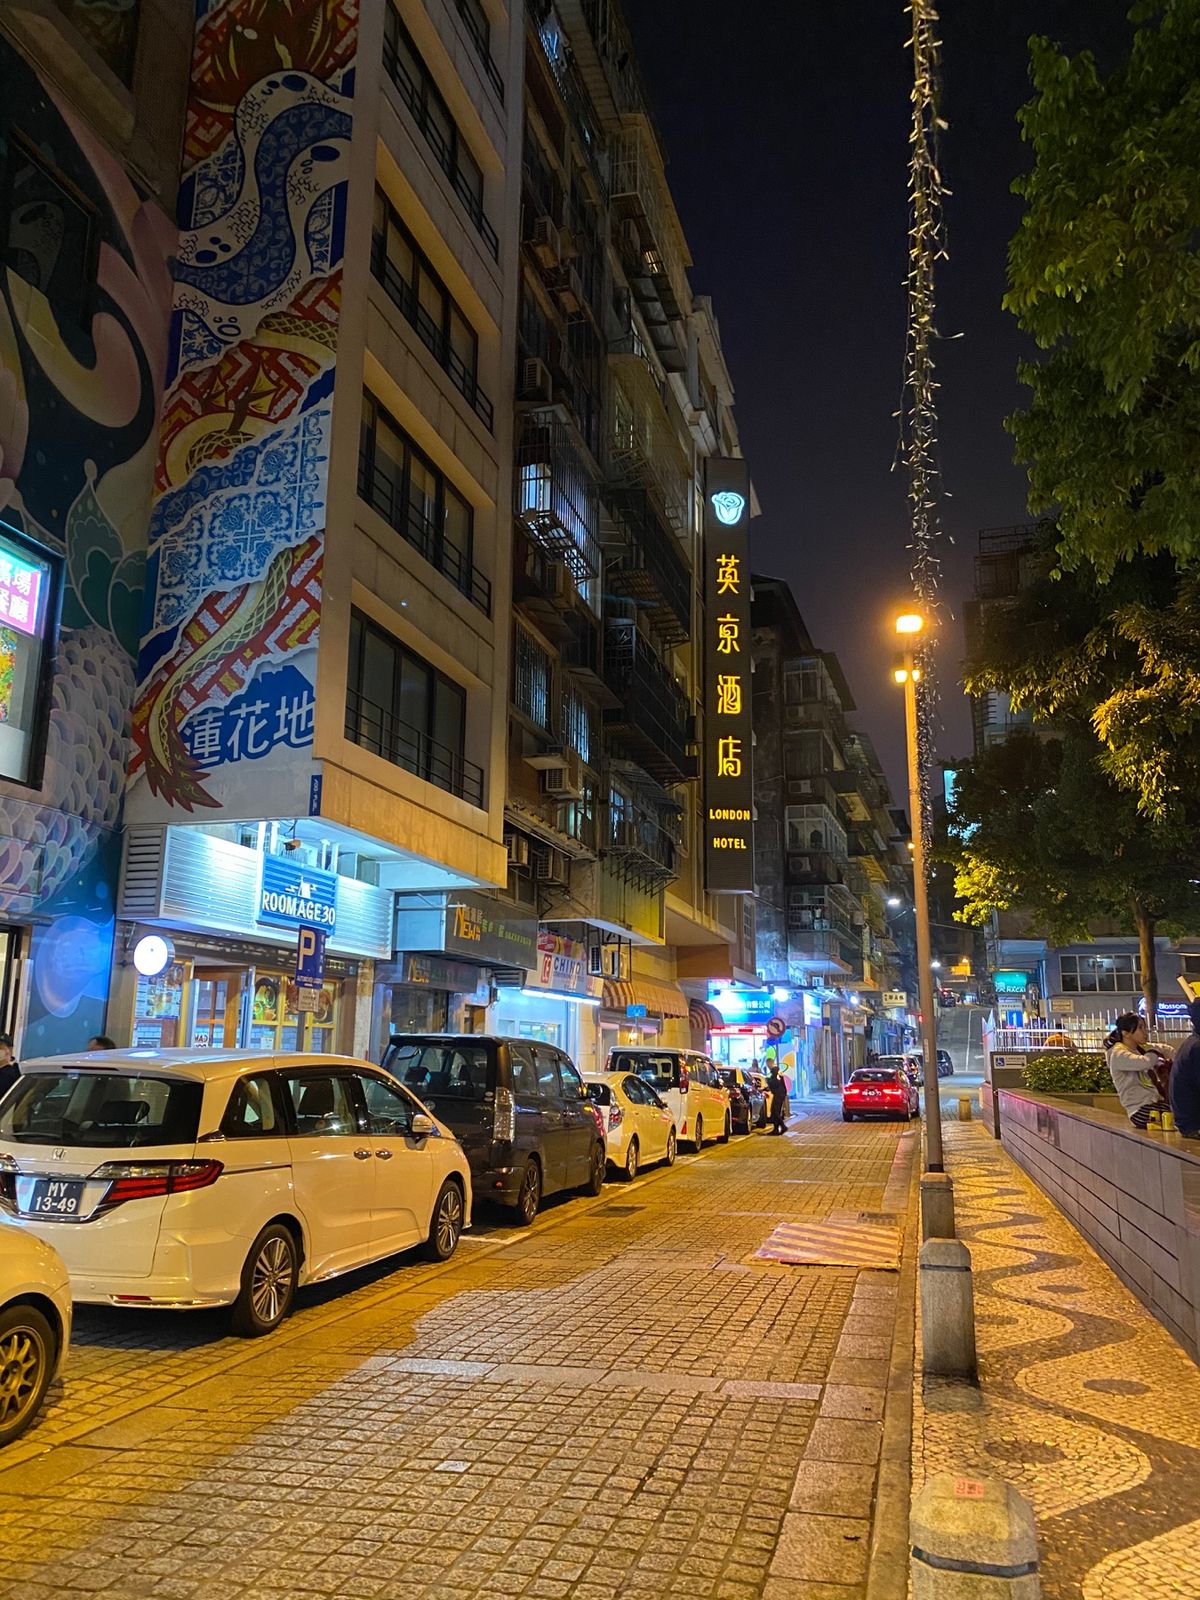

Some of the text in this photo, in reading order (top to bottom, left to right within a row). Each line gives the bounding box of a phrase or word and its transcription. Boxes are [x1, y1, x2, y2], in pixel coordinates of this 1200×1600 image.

[716, 554, 742, 777] 英京酒店
[709, 809, 750, 820] LONDON
[713, 838, 747, 849] HOTEL
[298, 929, 316, 971] P
[47, 1182, 69, 1198] MY
[35, 1196, 77, 1213] 13-49
